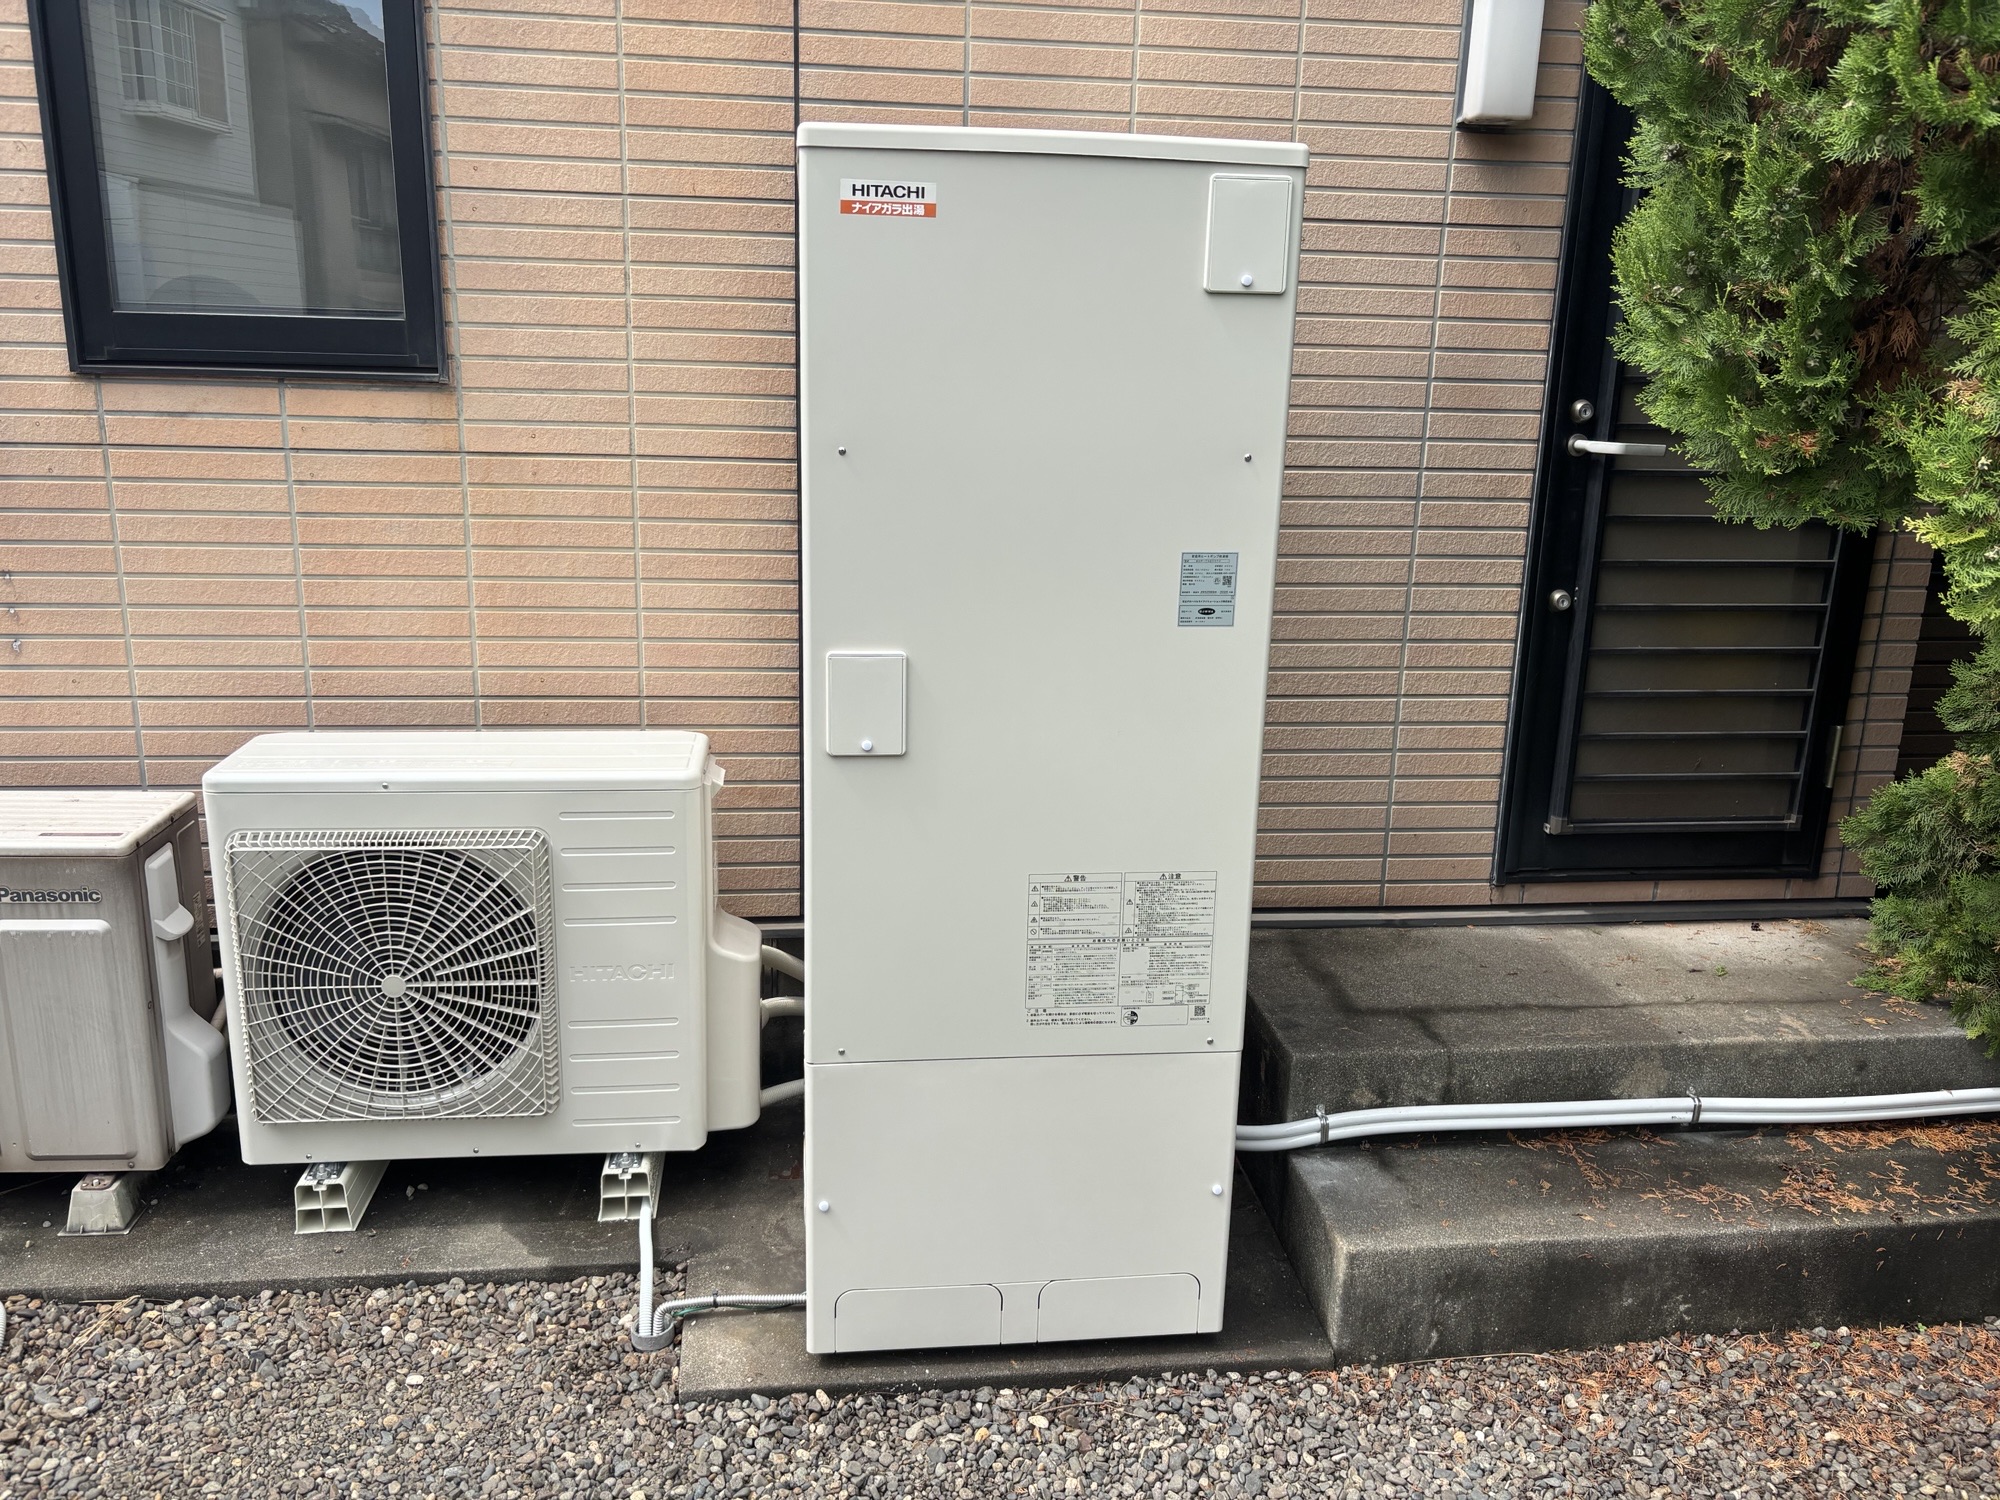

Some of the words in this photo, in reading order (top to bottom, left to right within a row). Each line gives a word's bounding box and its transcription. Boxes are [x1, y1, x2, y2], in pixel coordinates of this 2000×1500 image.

[852, 184, 925, 199] HITACHI
[852, 203, 925, 215] ナイアガラ出湯
[1073, 874, 1087, 882] 警告
[0, 887, 101, 903] Panasonic
[569, 963, 675, 982] HITACHI
